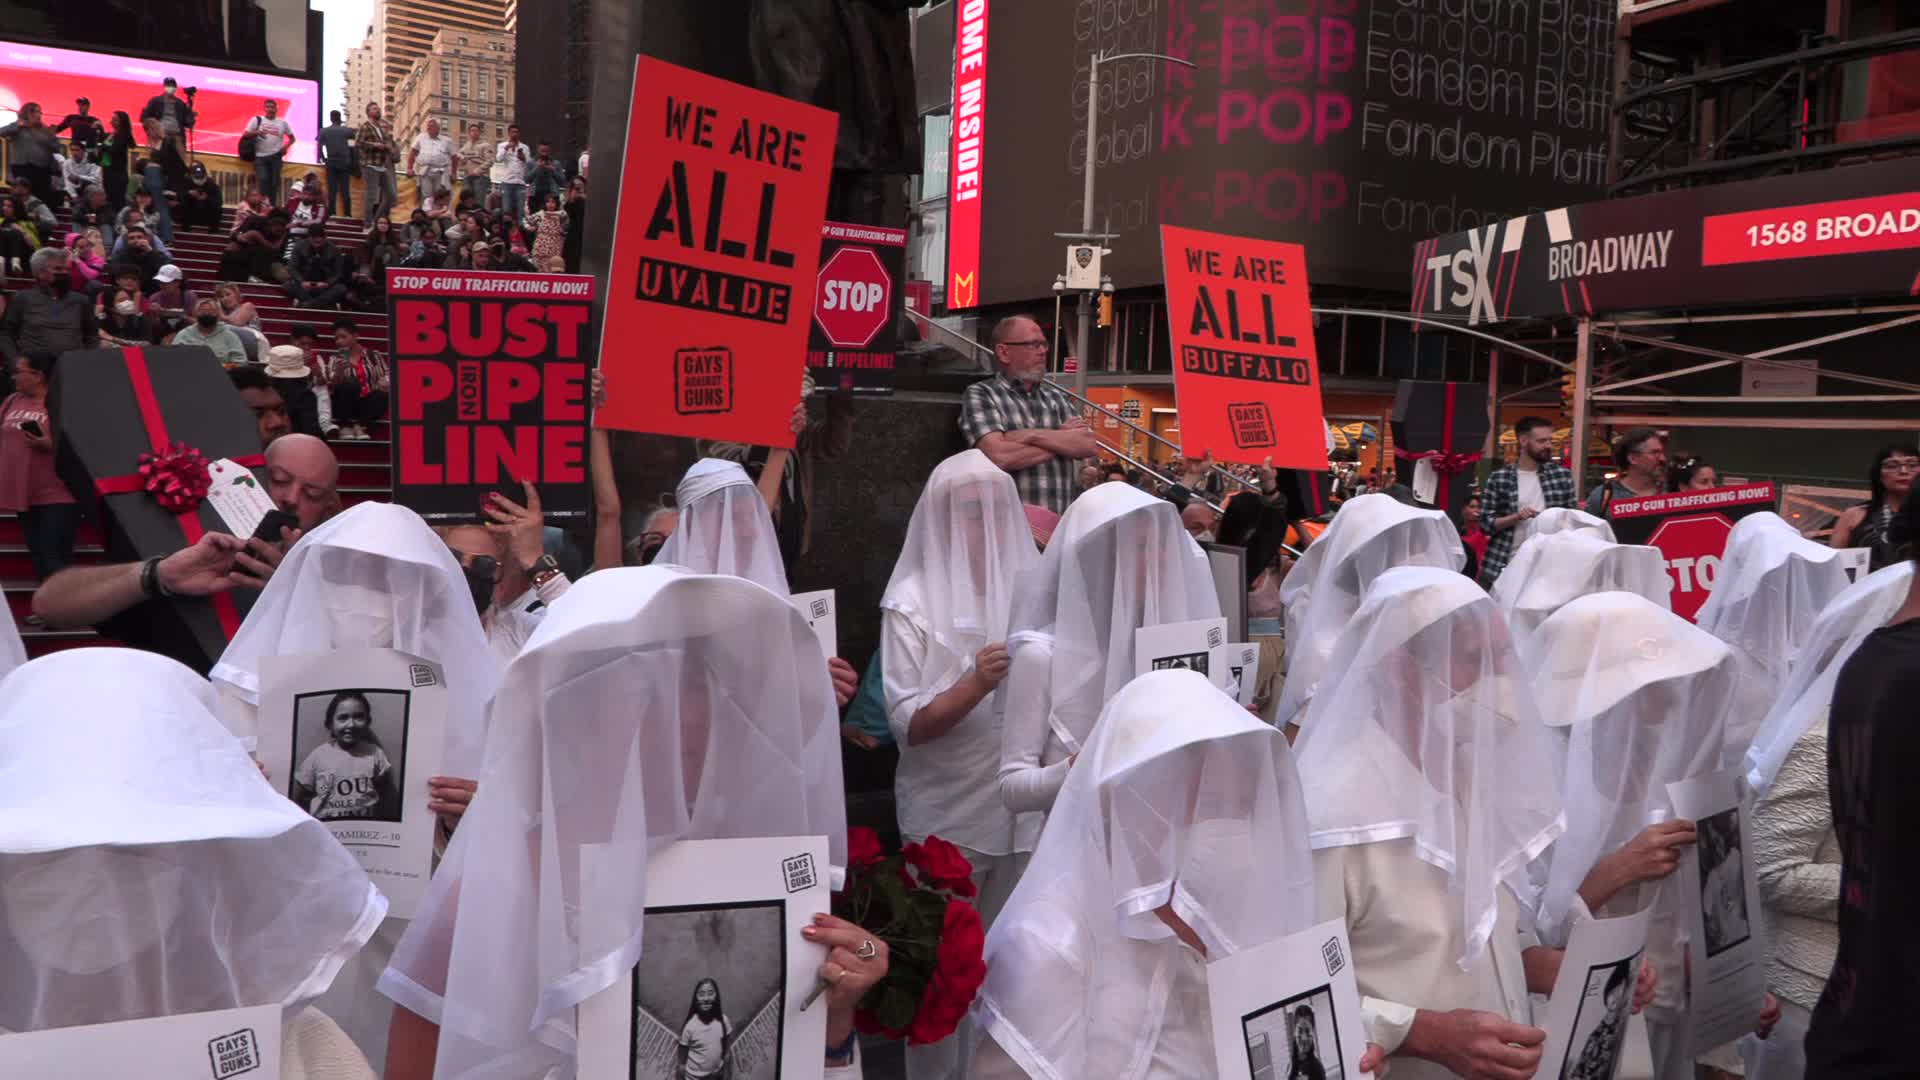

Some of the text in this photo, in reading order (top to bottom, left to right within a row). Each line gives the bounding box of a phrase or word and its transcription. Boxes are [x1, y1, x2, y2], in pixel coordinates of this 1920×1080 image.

[957, 0, 984, 202] OME INSIDE!
[665, 96, 807, 171] WE ARE
[1160, 89, 1352, 152] K-POP
[1361, 101, 1521, 176] Fandom
[645, 160, 795, 268] ALL
[1746, 220, 1807, 247] 1568
[1186, 248, 1286, 285] WE ARE
[1427, 223, 1499, 326] TSX
[1549, 230, 1673, 281] BROADWAY
[393, 277, 589, 295] STOP GUN TRAFFICKING NOW!
[639, 262, 786, 320] UVALDE
[823, 280, 883, 312] STOP
[396, 301, 588, 358] BUST
[1190, 285, 1297, 347] ALL
[684, 356, 723, 374] GAYS
[1184, 349, 1308, 382] BUFFALO
[461, 366, 477, 416] IRON
[685, 388, 724, 407] GUNS
[400, 425, 584, 485] LINE
[1614, 487, 1769, 514] STOP GUN TRAFFICKING NOW!
[216, 1035, 249, 1054] GAYS
[221, 1055, 253, 1074] GUNS
